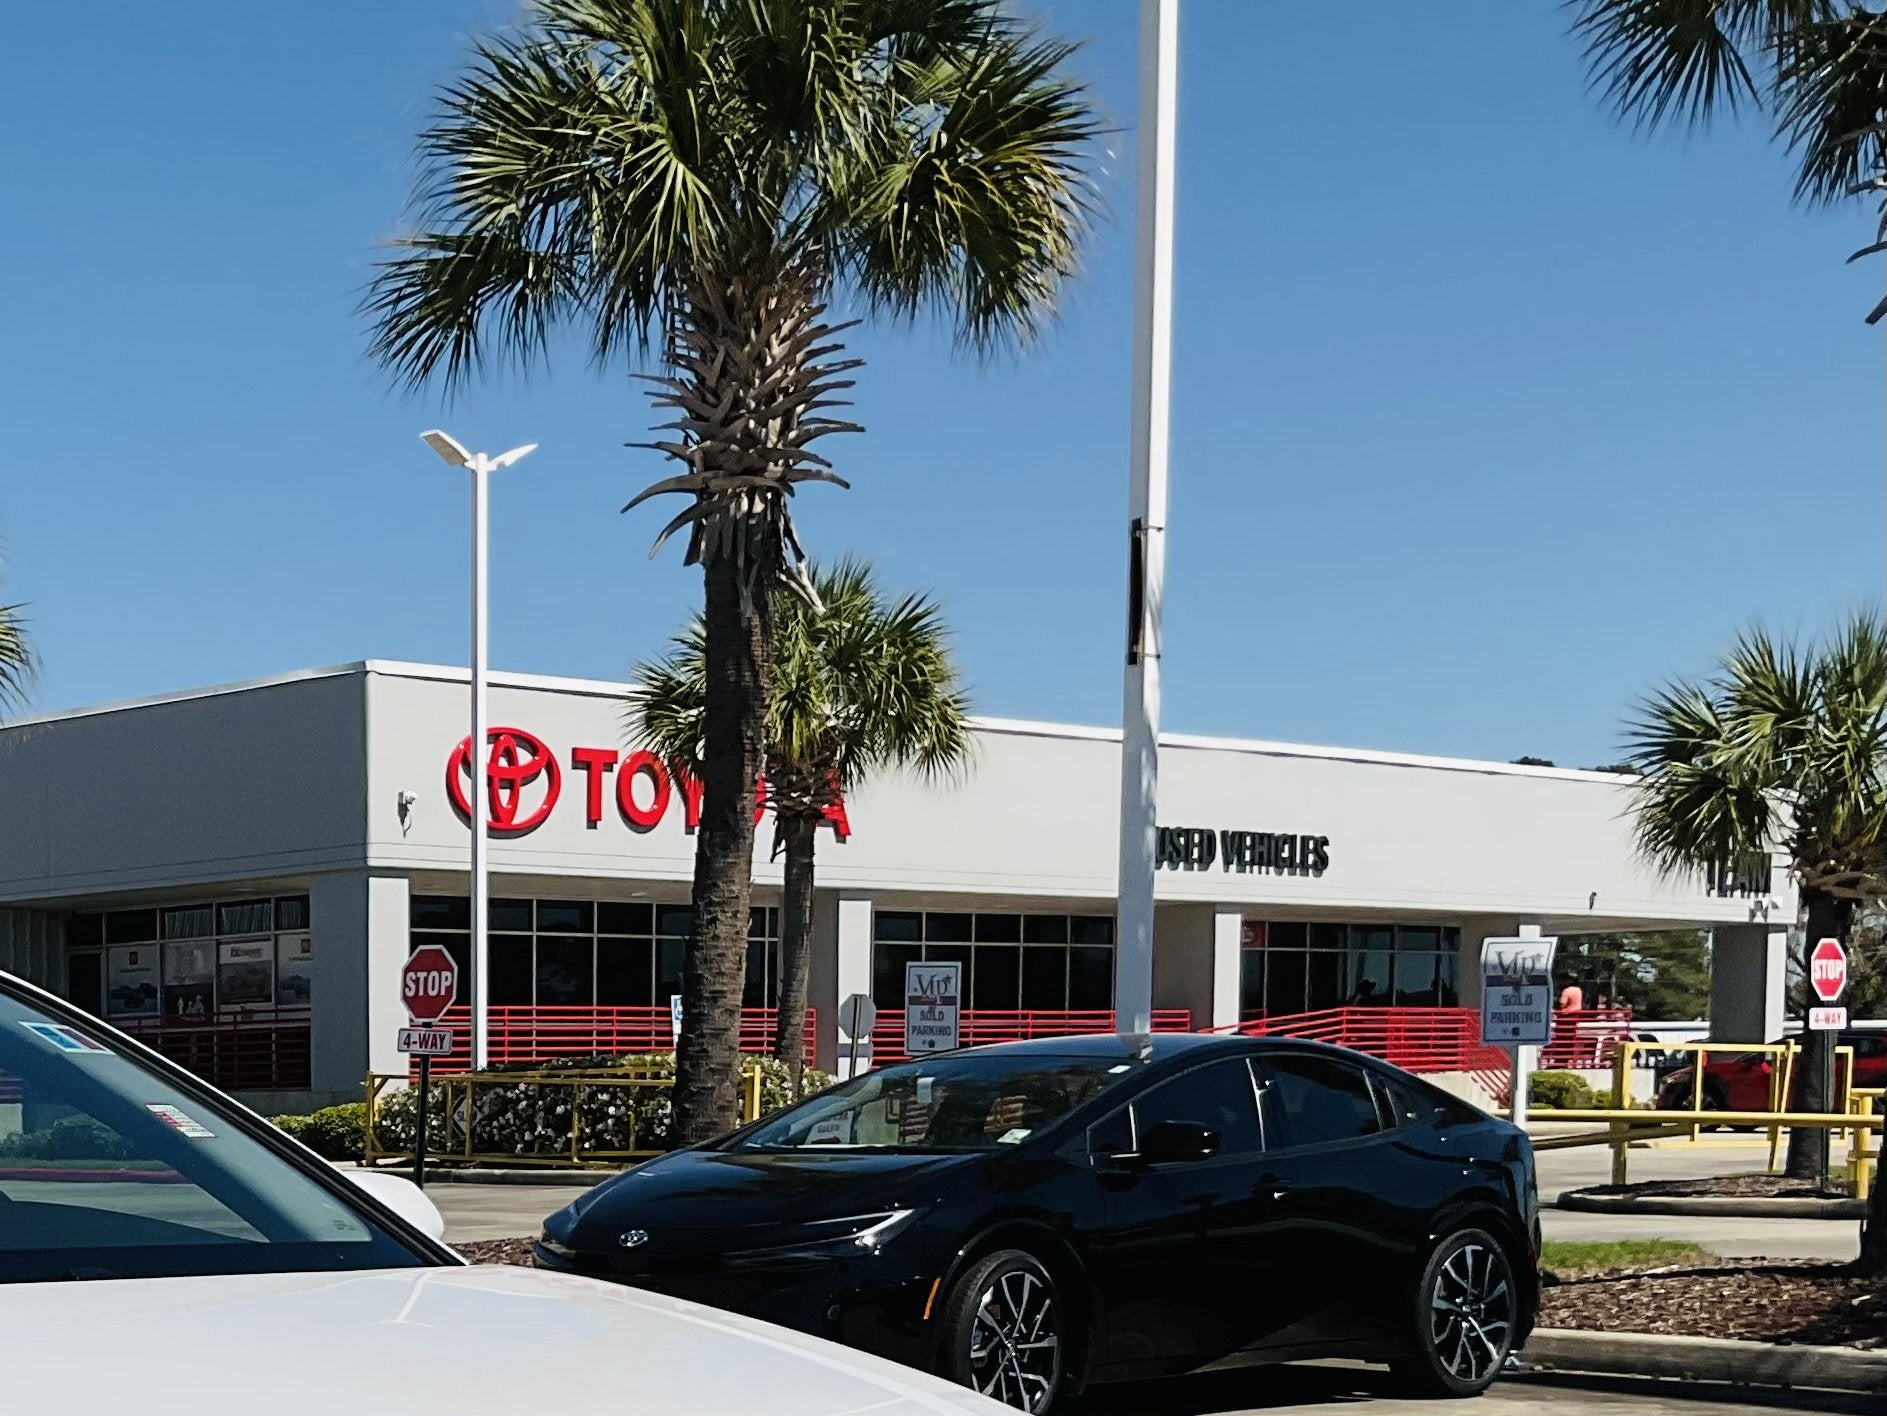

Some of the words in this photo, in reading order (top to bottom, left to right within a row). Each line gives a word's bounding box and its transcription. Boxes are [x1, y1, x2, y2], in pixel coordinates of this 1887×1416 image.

[1154, 827, 1216, 870] USED
[1220, 831, 1329, 874] VEHICLES
[1814, 959, 1844, 980] STOP
[404, 970, 452, 997] STOP
[919, 1010, 945, 1021] SOLD
[1490, 1011, 1542, 1024] PARKING
[1814, 1012, 1841, 1025] 4-WAY
[911, 1025, 952, 1037] PARKING
[403, 1032, 447, 1050] 4-WAY
